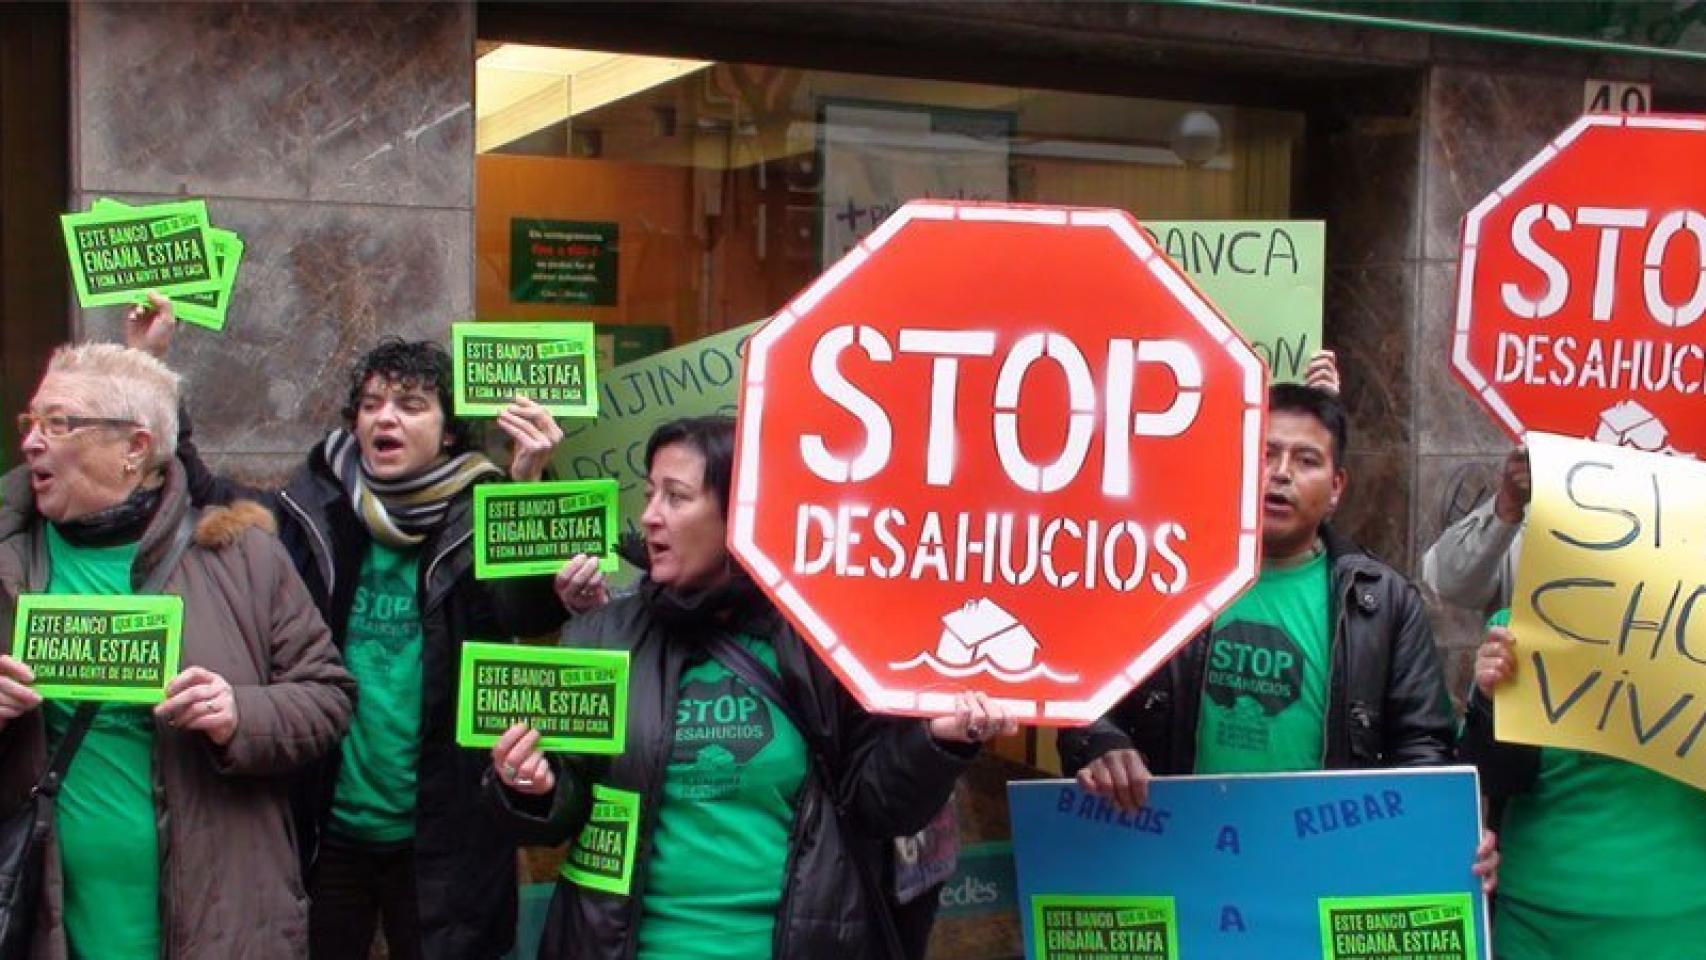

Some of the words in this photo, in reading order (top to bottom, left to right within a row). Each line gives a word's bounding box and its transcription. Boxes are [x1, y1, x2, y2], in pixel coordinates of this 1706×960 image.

[80, 230, 107, 248] ESTE
[109, 224, 149, 245] BANCO
[147, 238, 202, 266] ESTAFA
[467, 343, 493, 359] ESTE
[496, 343, 533, 360] BANCO
[1495, 332, 1706, 394] DESAHUC
[530, 364, 581, 385] ESTAFA
[800, 323, 1203, 496] STOP
[489, 502, 516, 519] ESTE
[517, 499, 555, 517] BANCO
[551, 515, 602, 540] ESTAFA
[793, 501, 1188, 595] DESAHUCIOS
[32, 615, 61, 634] ESTE
[64, 615, 107, 634] BANCO
[100, 639, 161, 665] ESTAFA
[1212, 639, 1294, 679] STOP
[479, 665, 509, 685] ESTE
[511, 667, 555, 687] BANCO
[550, 691, 610, 716] ESTAFA
[676, 694, 757, 724] STOP
[675, 725, 763, 741] ESAHUCIOS
[1215, 824, 1241, 856] A
[1294, 789, 1404, 839] ROBAR
[1219, 904, 1246, 933] A
[1334, 914, 1364, 931] ESTE
[1366, 912, 1407, 930] BANCO
[1110, 930, 1163, 952] ESTAFA
[1402, 929, 1462, 953] ESTAFA
